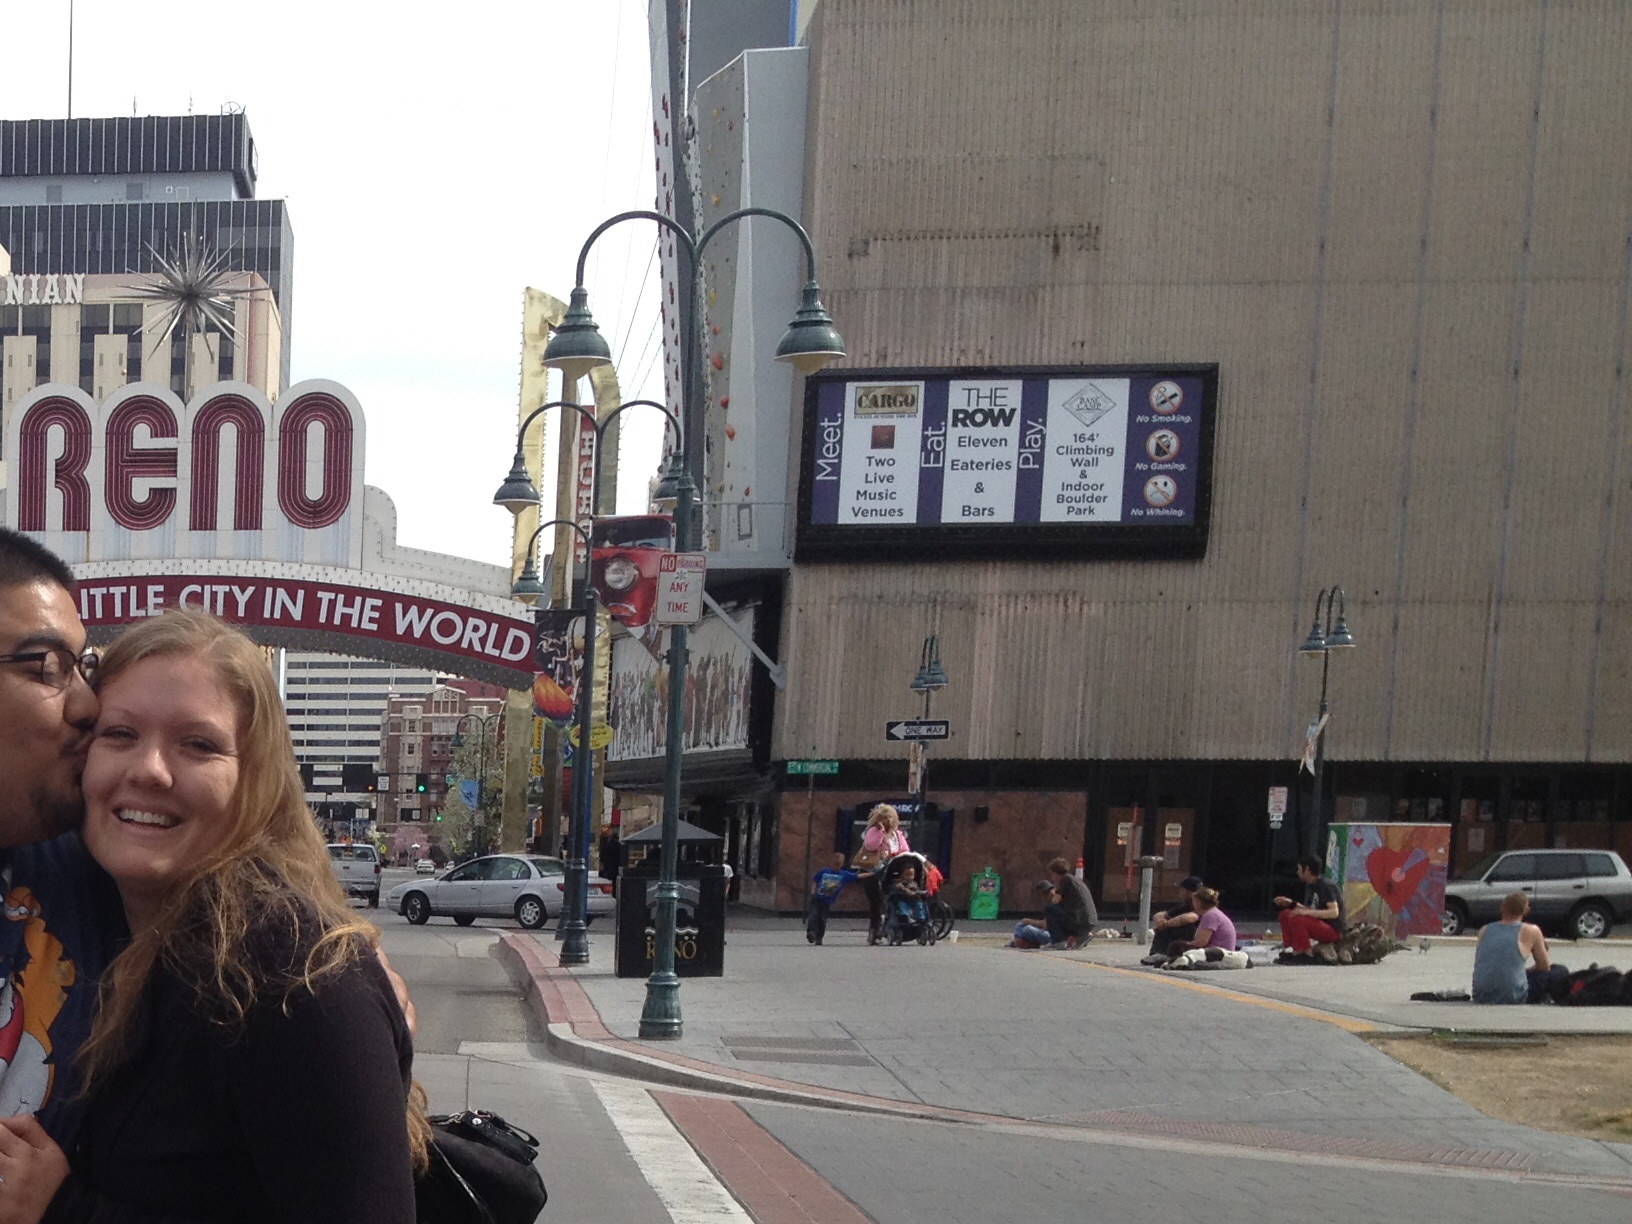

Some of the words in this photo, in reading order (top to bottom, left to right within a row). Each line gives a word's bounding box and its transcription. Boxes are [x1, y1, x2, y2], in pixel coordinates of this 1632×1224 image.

[857, 393, 916, 409] CARGO
[961, 387, 1009, 407] THE
[951, 407, 1017, 428] ROW
[1136, 414, 1150, 423] No
[920, 421, 946, 468] Eat.
[957, 436, 1008, 448] Eleven
[1019, 418, 1046, 470] Play.
[1073, 433, 1099, 444] 164'
[815, 412, 843, 480] Meet.
[1055, 445, 1115, 458] Climbing
[18, 391, 354, 532] RENO
[866, 456, 896, 467] Two
[950, 458, 1012, 471] Eateries
[1070, 457, 1099, 468] Wall
[1135, 462, 1149, 471] No
[864, 472, 895, 484] Live
[1079, 469, 1088, 480] &
[974, 482, 985, 494] &
[1061, 481, 1105, 492] Indoor
[855, 488, 897, 501] Music
[1056, 494, 1108, 505] Boulder
[851, 506, 904, 518] Venues
[961, 504, 995, 517] Bars
[1066, 505, 1096, 516] Park
[1131, 508, 1145, 516] No
[662, 556, 675, 570] NO
[669, 582, 689, 593] ANY
[667, 601, 689, 613] TIME
[77, 584, 165, 620] ITTLE
[179, 584, 256, 618] CITY
[263, 587, 306, 622] IN
[316, 591, 383, 631] THE
[394, 602, 532, 662] WORLD
[905, 726, 922, 735] ONE
[926, 726, 944, 734] WAY
[646, 940, 697, 959] RNO
